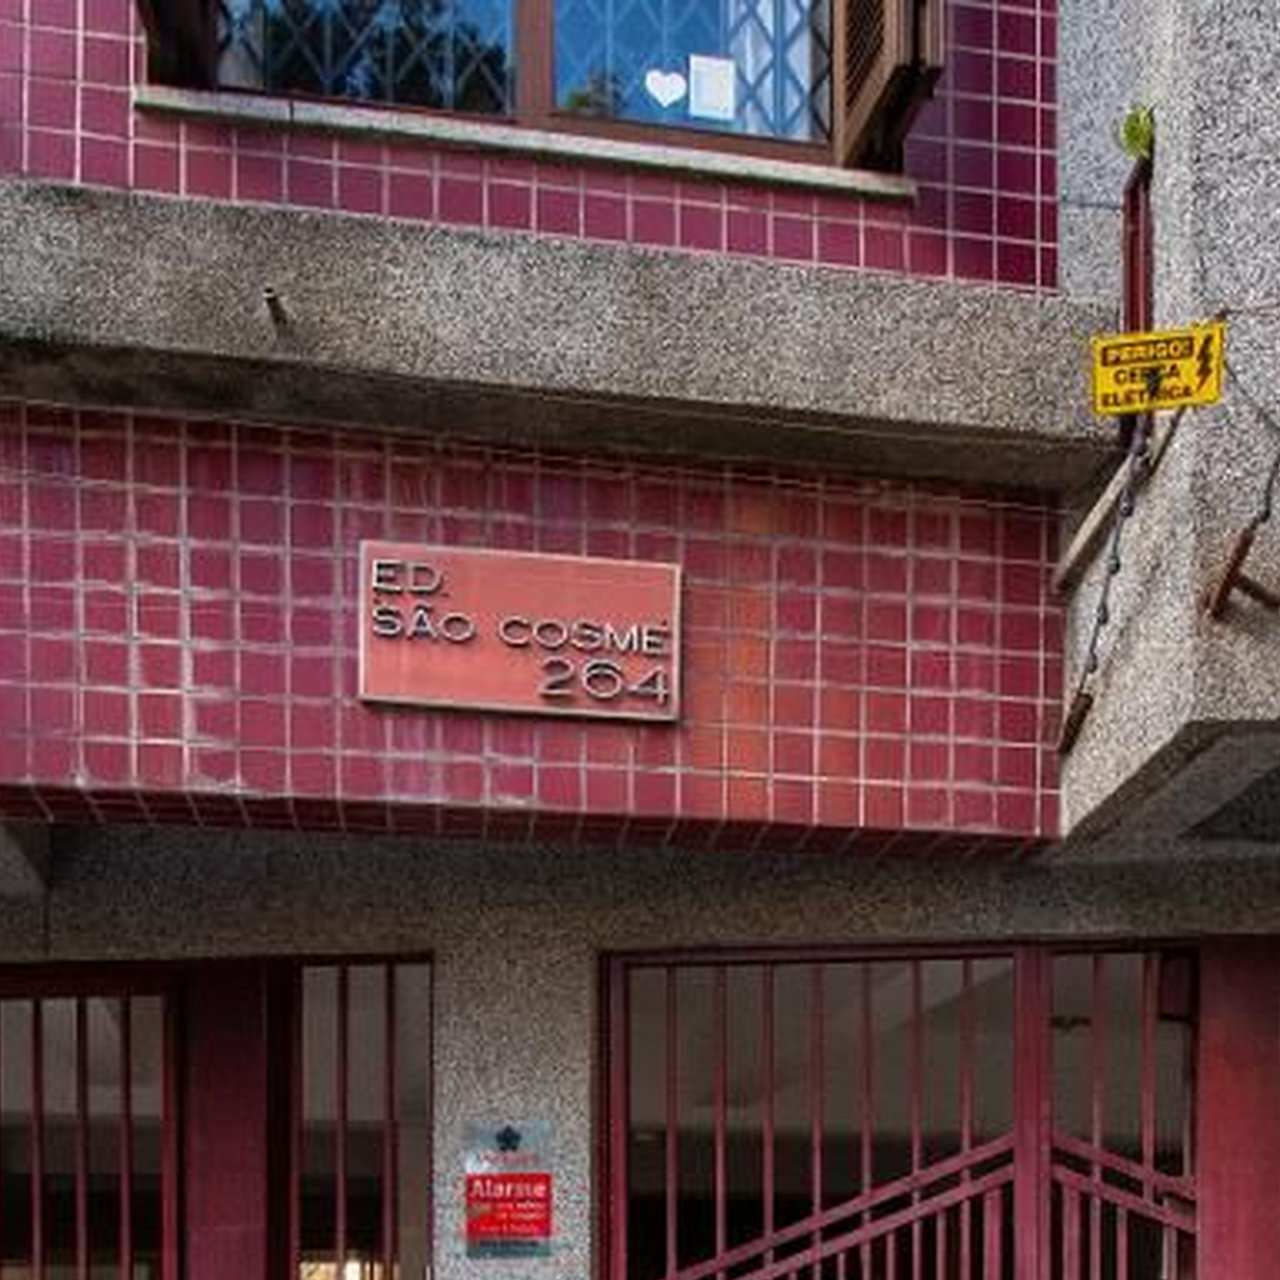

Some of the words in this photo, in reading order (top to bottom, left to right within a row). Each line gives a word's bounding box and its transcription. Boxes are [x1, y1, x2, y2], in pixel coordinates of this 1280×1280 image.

[371, 600, 475, 641] SÃO
[499, 615, 668, 656] COSME
[538, 658, 668, 704] 264
